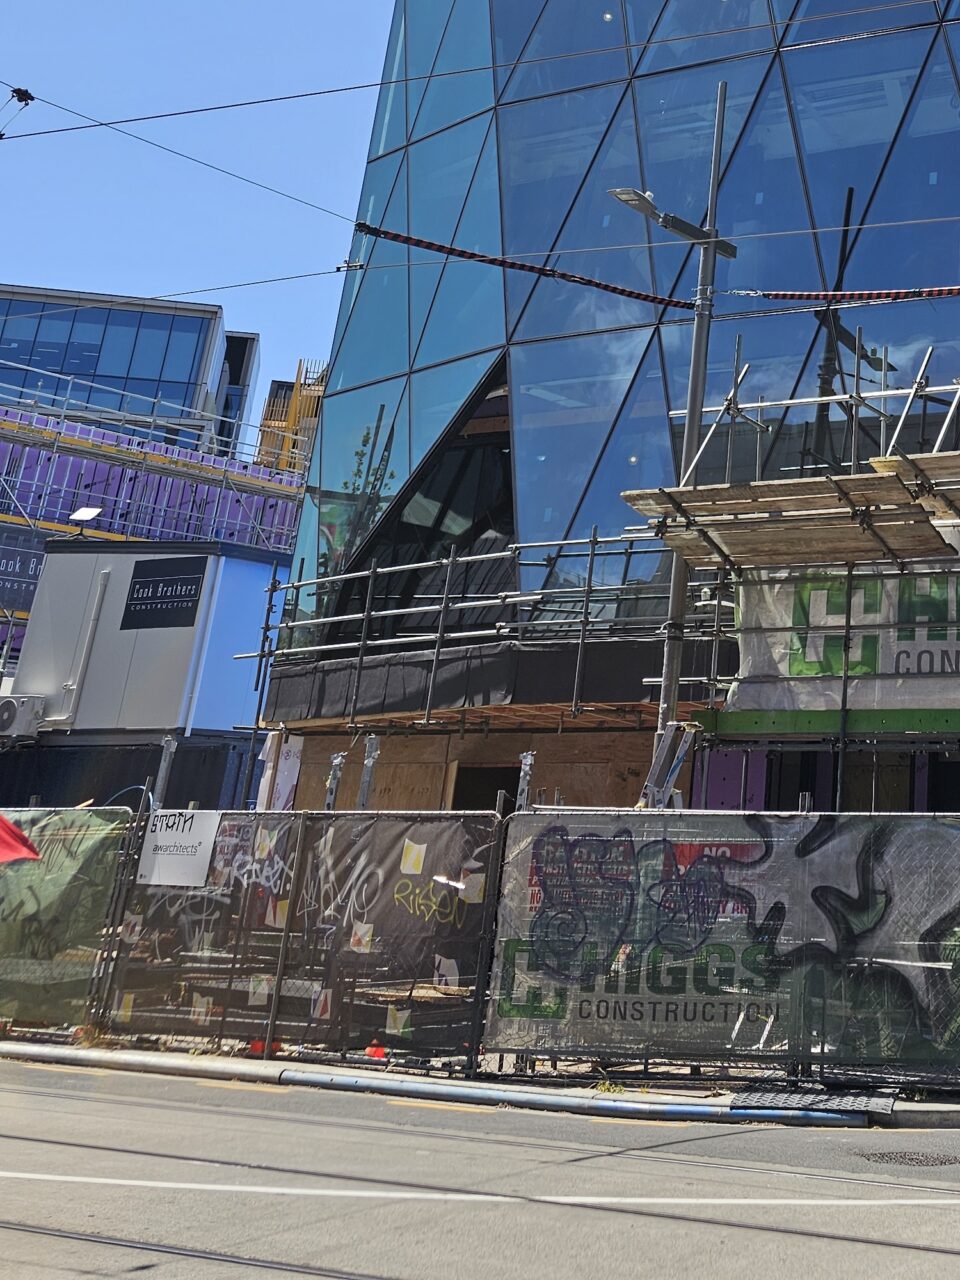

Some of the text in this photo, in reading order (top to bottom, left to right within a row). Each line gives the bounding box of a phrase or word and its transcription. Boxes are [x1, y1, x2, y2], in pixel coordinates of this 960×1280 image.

[0, 556, 21, 572] ook
[134, 582, 196, 598] Cook Brothers
[131, 601, 193, 610] CONSTRUCTION
[153, 841, 198, 854] awarchitects
[577, 942, 781, 996] HIGGS
[577, 998, 781, 1023] CONSTRUCTION
